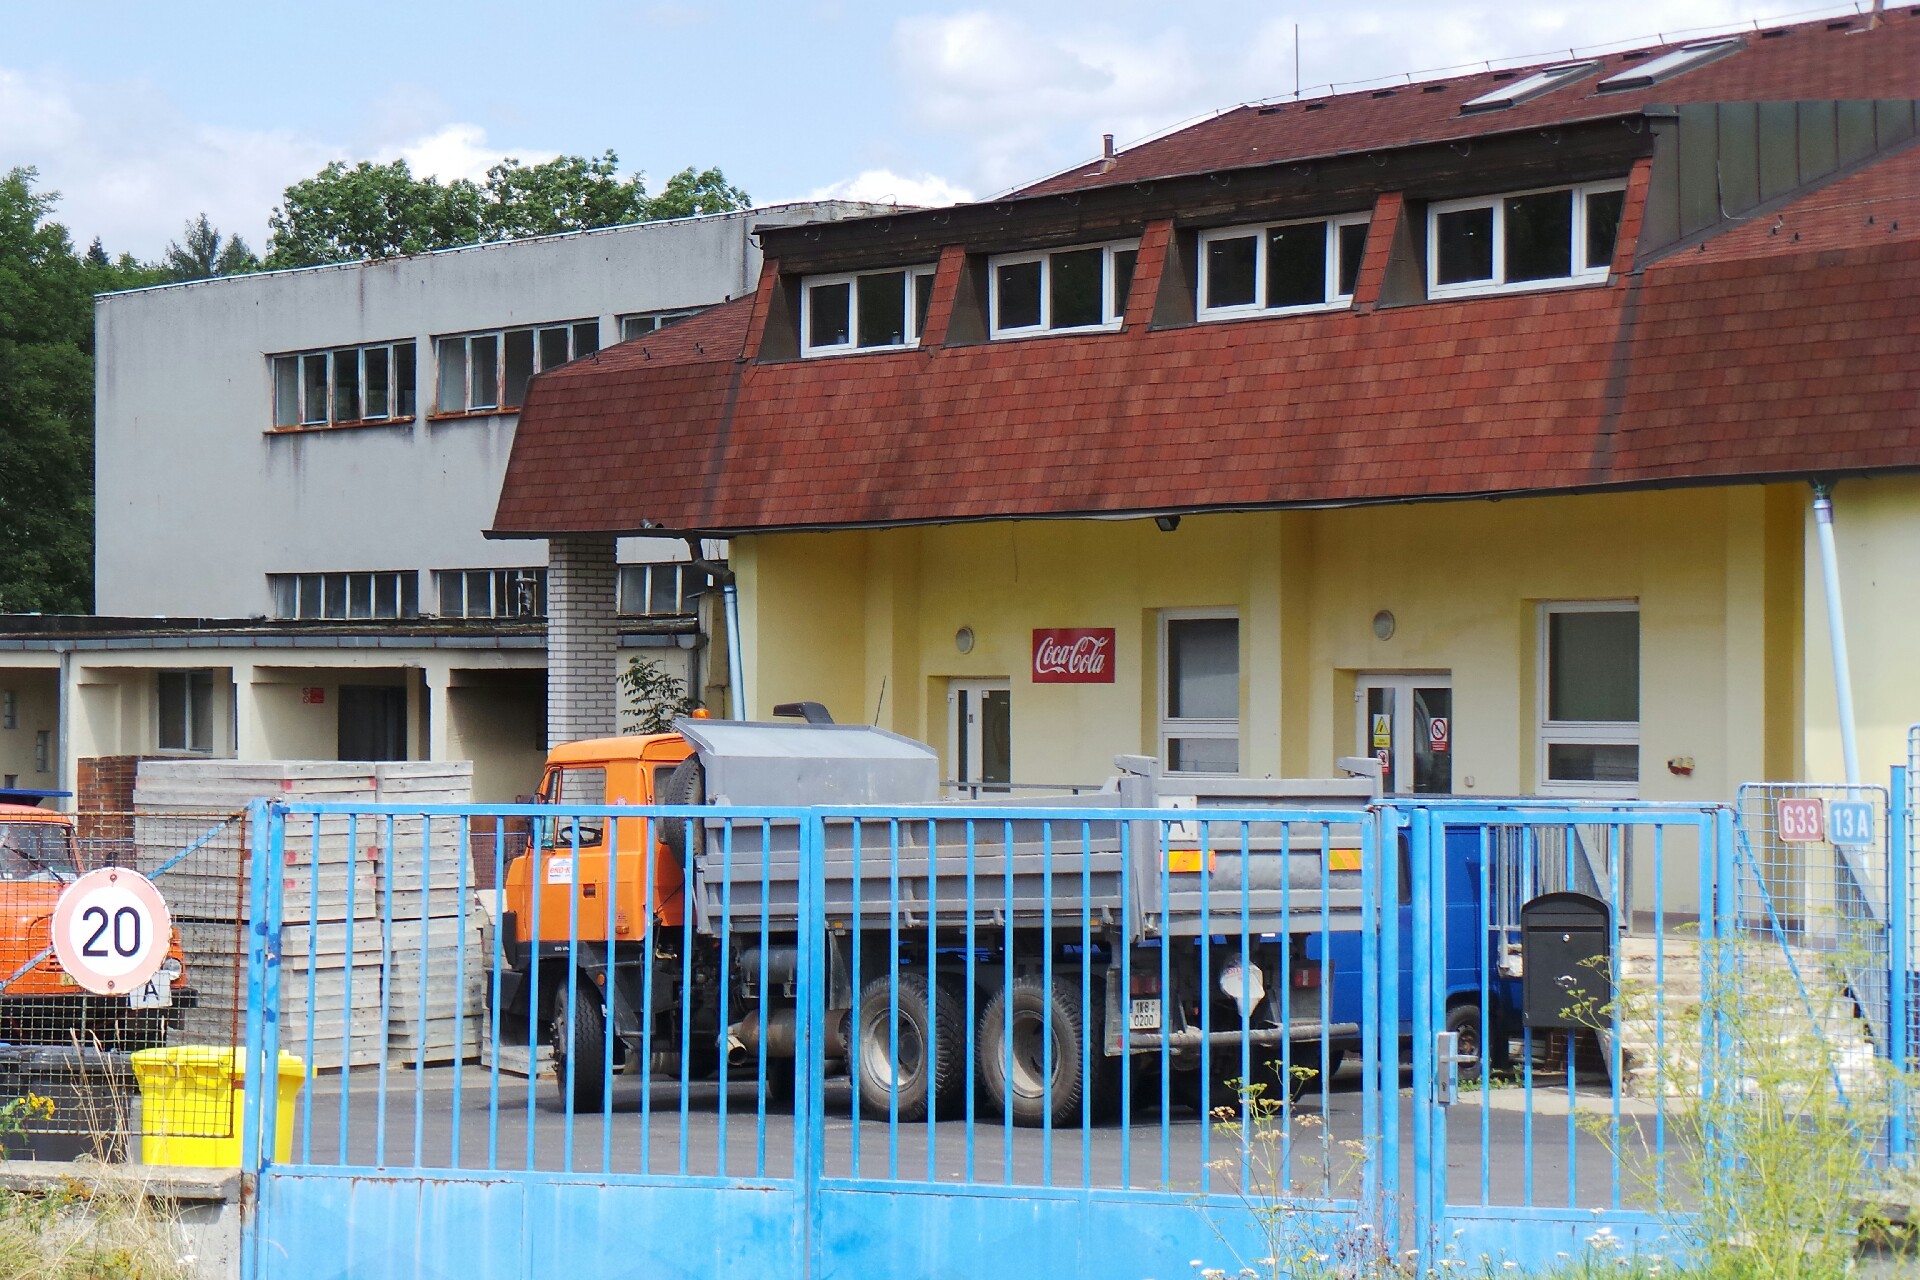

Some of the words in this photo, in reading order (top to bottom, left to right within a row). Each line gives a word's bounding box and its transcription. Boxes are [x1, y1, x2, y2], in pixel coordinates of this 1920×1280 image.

[1036, 636, 1109, 674] Coca-Cola
[1783, 805, 1818, 834] 633
[82, 906, 141, 957] 20
[143, 979, 160, 1002] A
[1134, 1014, 1154, 1027] 0200
